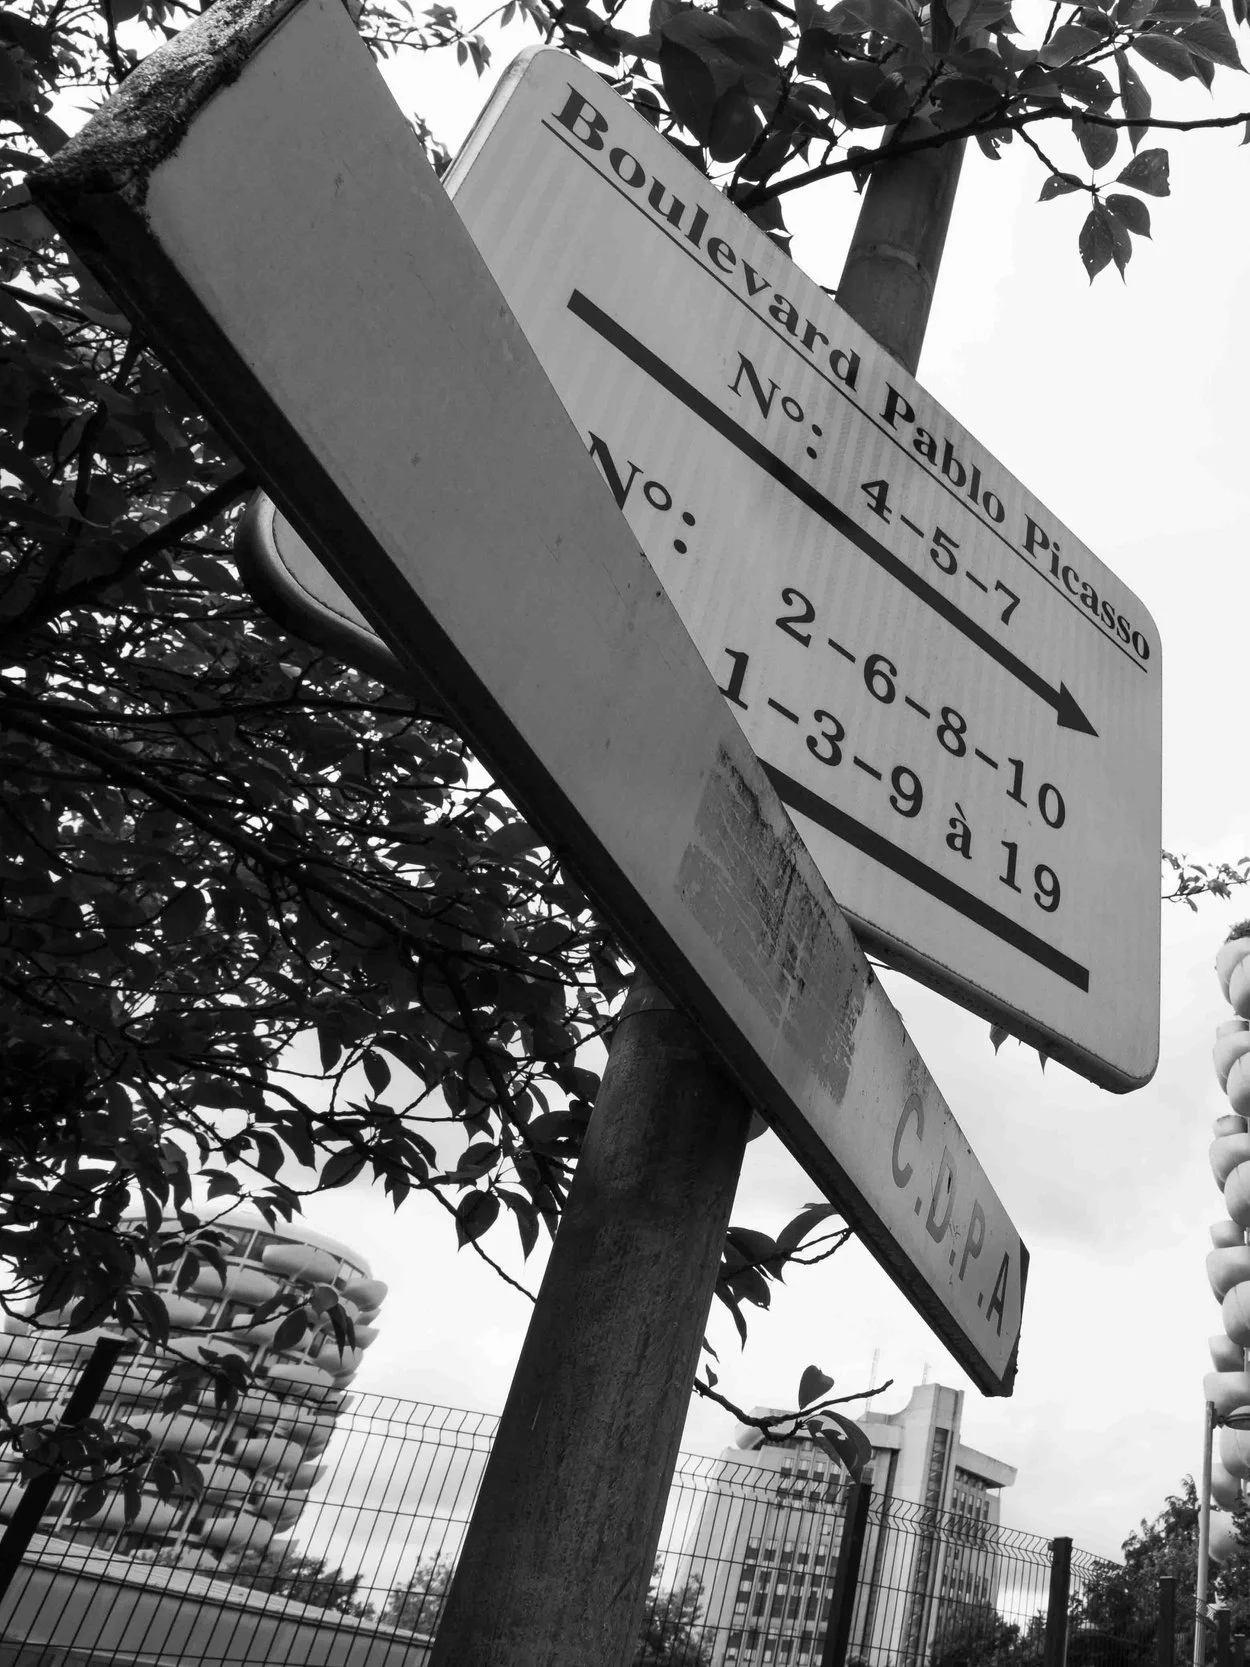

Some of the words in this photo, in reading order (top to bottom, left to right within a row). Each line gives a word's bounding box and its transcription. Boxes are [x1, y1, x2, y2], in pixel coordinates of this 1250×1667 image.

[551, 82, 861, 393] Boulevard
[878, 381, 1005, 524] Pablo
[1022, 513, 1150, 661] Picasso
[860, 479, 1021, 626] 4-5-7
[775, 587, 1066, 829] 2-6-8-10
[945, 802, 973, 860] à
[999, 840, 1061, 913] 19
